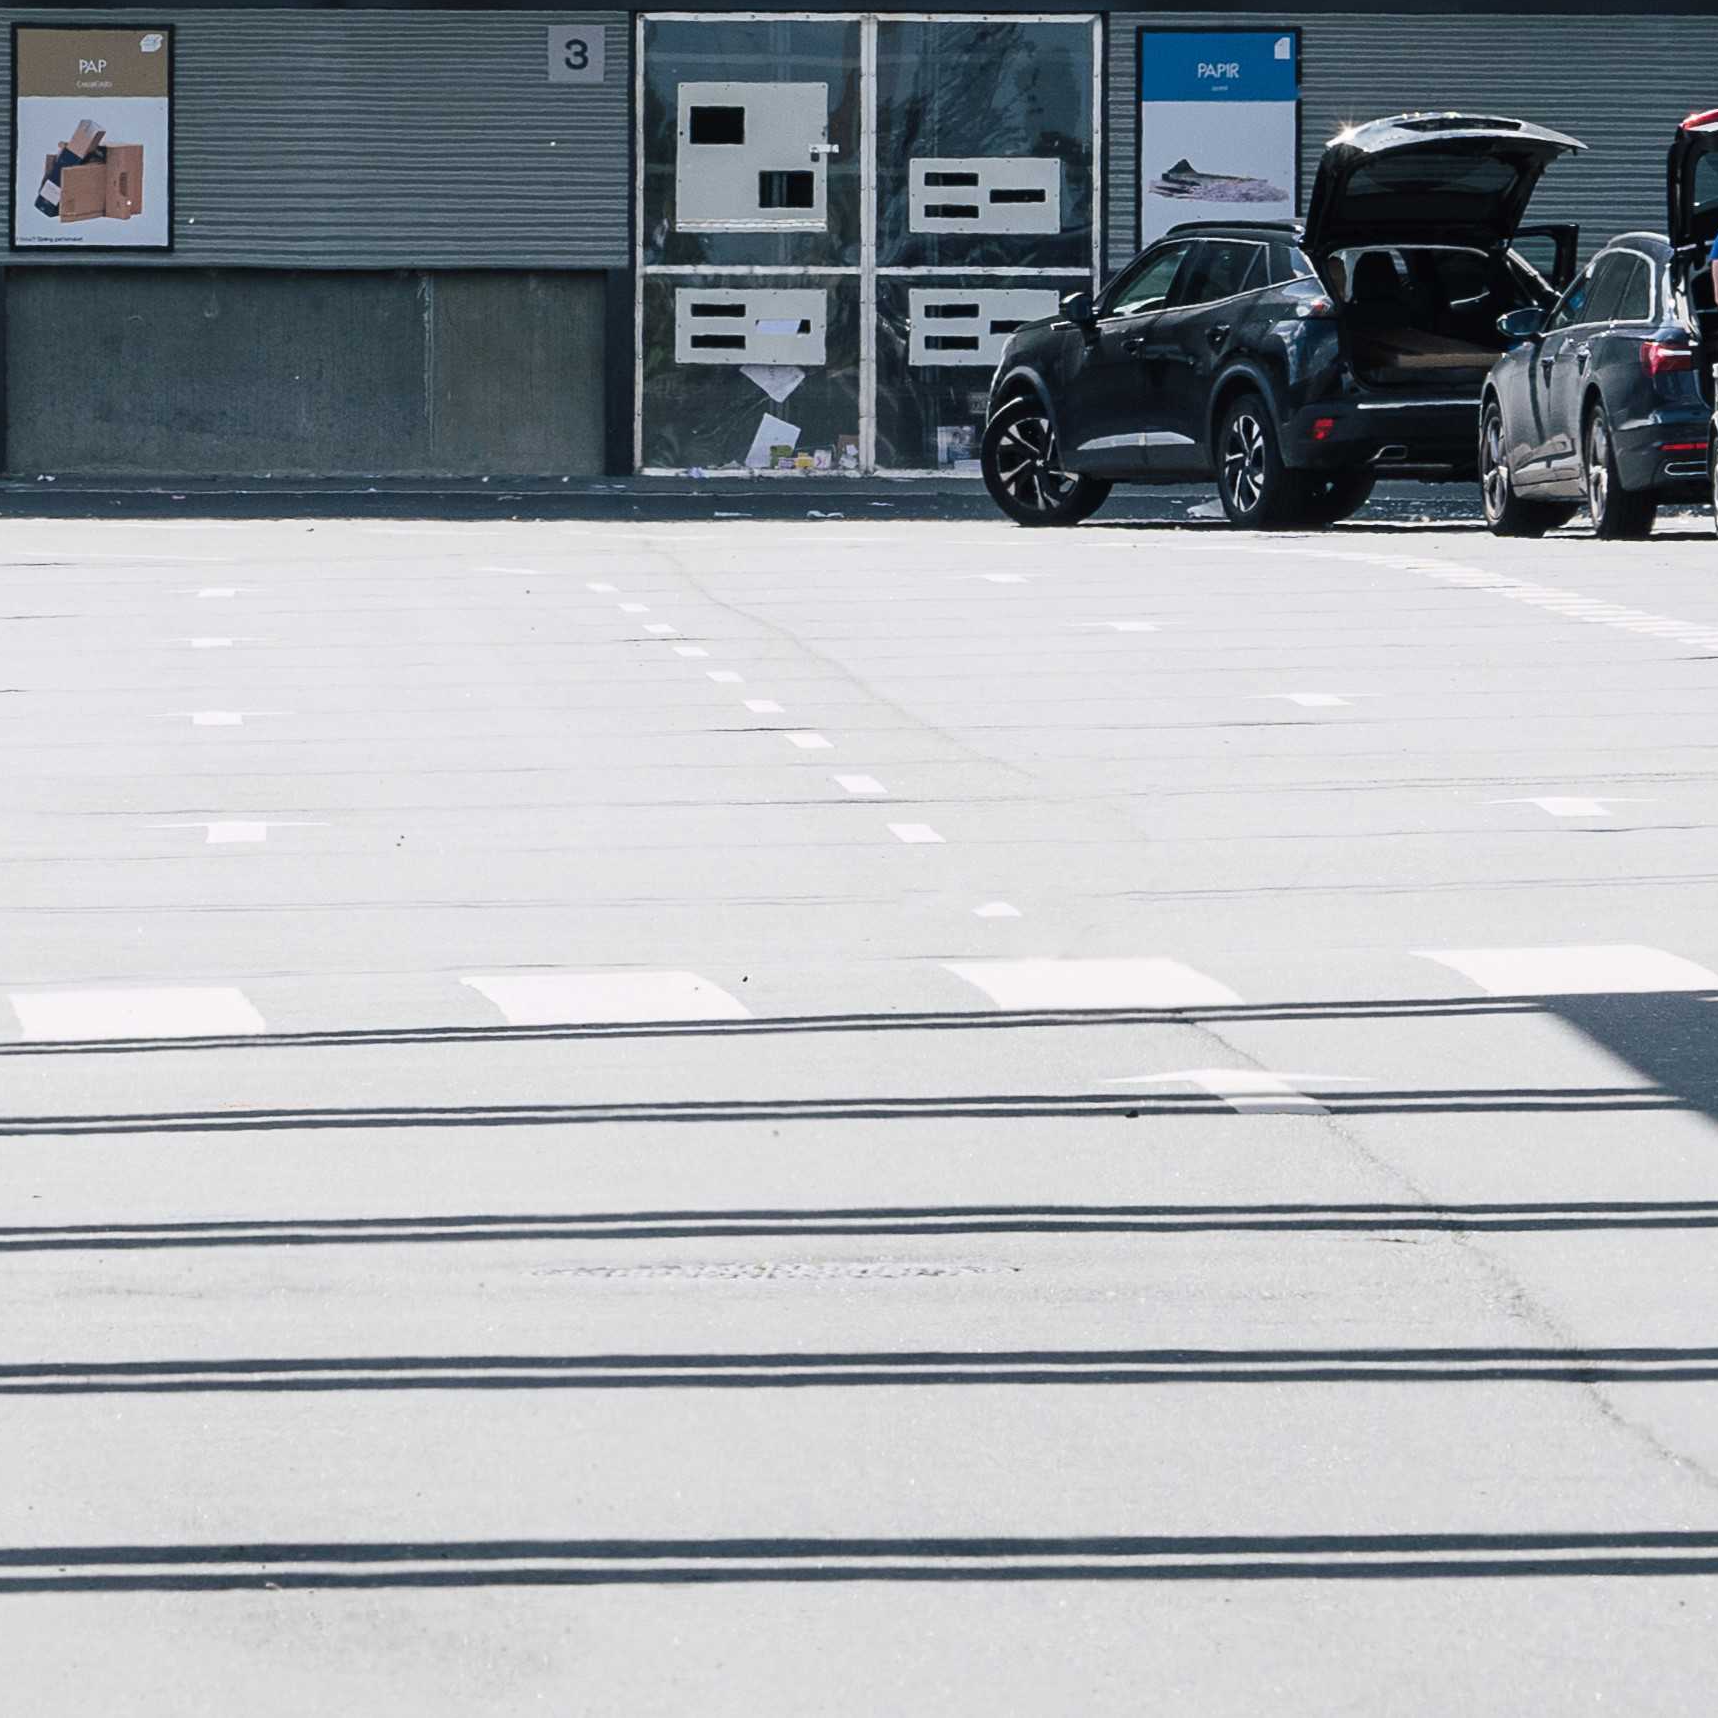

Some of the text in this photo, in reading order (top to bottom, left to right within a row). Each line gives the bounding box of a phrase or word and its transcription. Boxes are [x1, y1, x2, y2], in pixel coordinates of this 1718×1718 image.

[565, 38, 589, 70] 3
[78, 59, 107, 74] PAP
[1197, 62, 1240, 79] PAPIR
